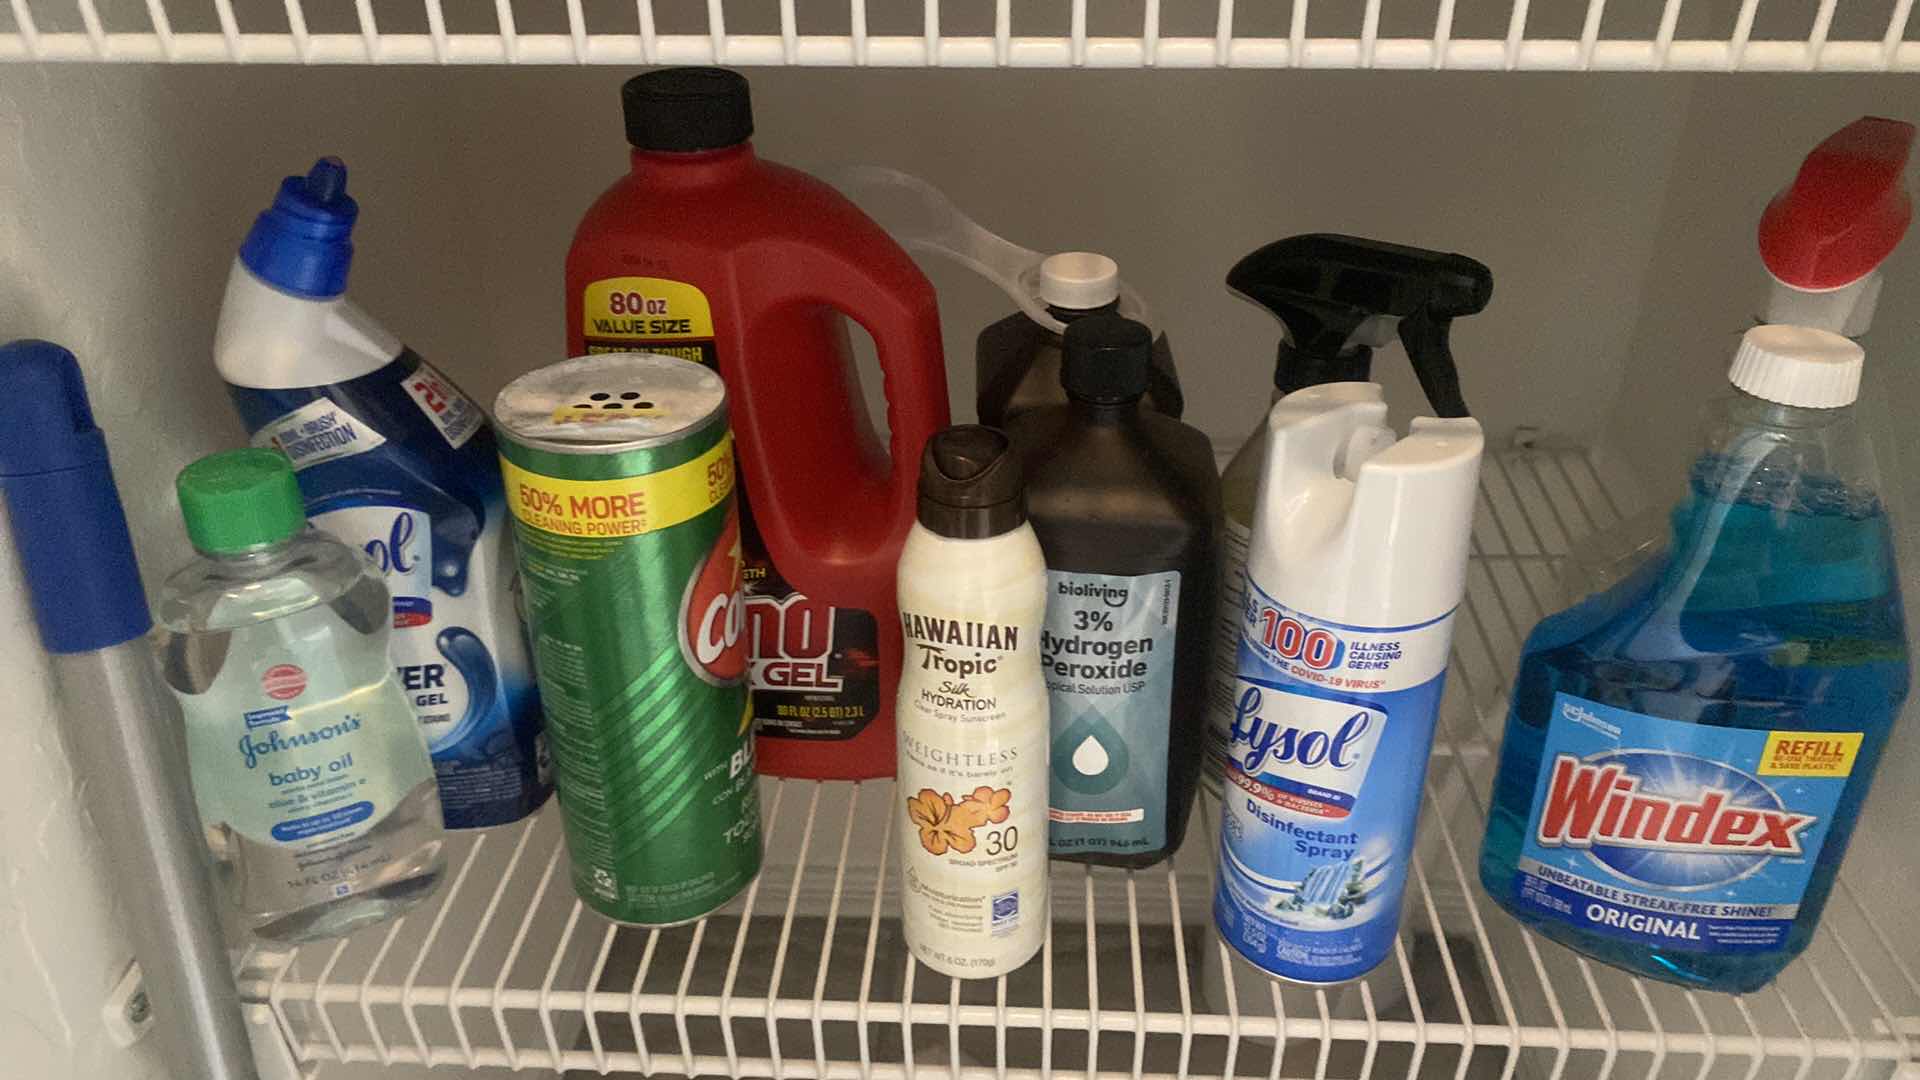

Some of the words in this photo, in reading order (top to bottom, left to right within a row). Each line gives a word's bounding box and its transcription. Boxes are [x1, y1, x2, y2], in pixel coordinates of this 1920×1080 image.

[610, 291, 643, 315] 80
[592, 319, 646, 335] VALUE
[649, 319, 692, 335] SIZE
[519, 482, 564, 517] 50%
[569, 491, 646, 521] MORE
[521, 507, 583, 536] CLEANING
[1058, 581, 1129, 607] bioliving
[902, 611, 1019, 652] HAWAIIAN
[1073, 609, 1114, 632] 3%
[1040, 630, 1153, 660] Hydrogen
[1262, 606, 1341, 671] 100
[1350, 640, 1401, 652] ILLNESS
[915, 643, 999, 680] Tropic
[1040, 653, 1148, 680] Peroxide
[1347, 660, 1390, 670] GERMS
[1349, 650, 1403, 661] CAUSING
[762, 662, 840, 690] GEL
[938, 680, 977, 699] Silk
[1077, 684, 1121, 696] Solution
[1291, 665, 1343, 688] COVID-19
[415, 693, 449, 707] GEL
[921, 688, 997, 711] HYDRATION
[237, 714, 361, 769] Johnson's
[1230, 686, 1370, 771] Lysol
[903, 730, 1018, 768] WEIGHTLESS
[1775, 739, 1845, 756] REFILL
[268, 766, 321, 786] baby
[327, 752, 353, 772] oil
[1541, 757, 1805, 853] Windex
[1247, 798, 1359, 845] Disinfectant
[985, 826, 1019, 856] 30
[1295, 839, 1355, 861] Spray
[1538, 864, 1618, 900] UNBEATABLE
[1622, 892, 1717, 916] STREAK-FREE
[1585, 903, 1701, 940] ORIGINAL
